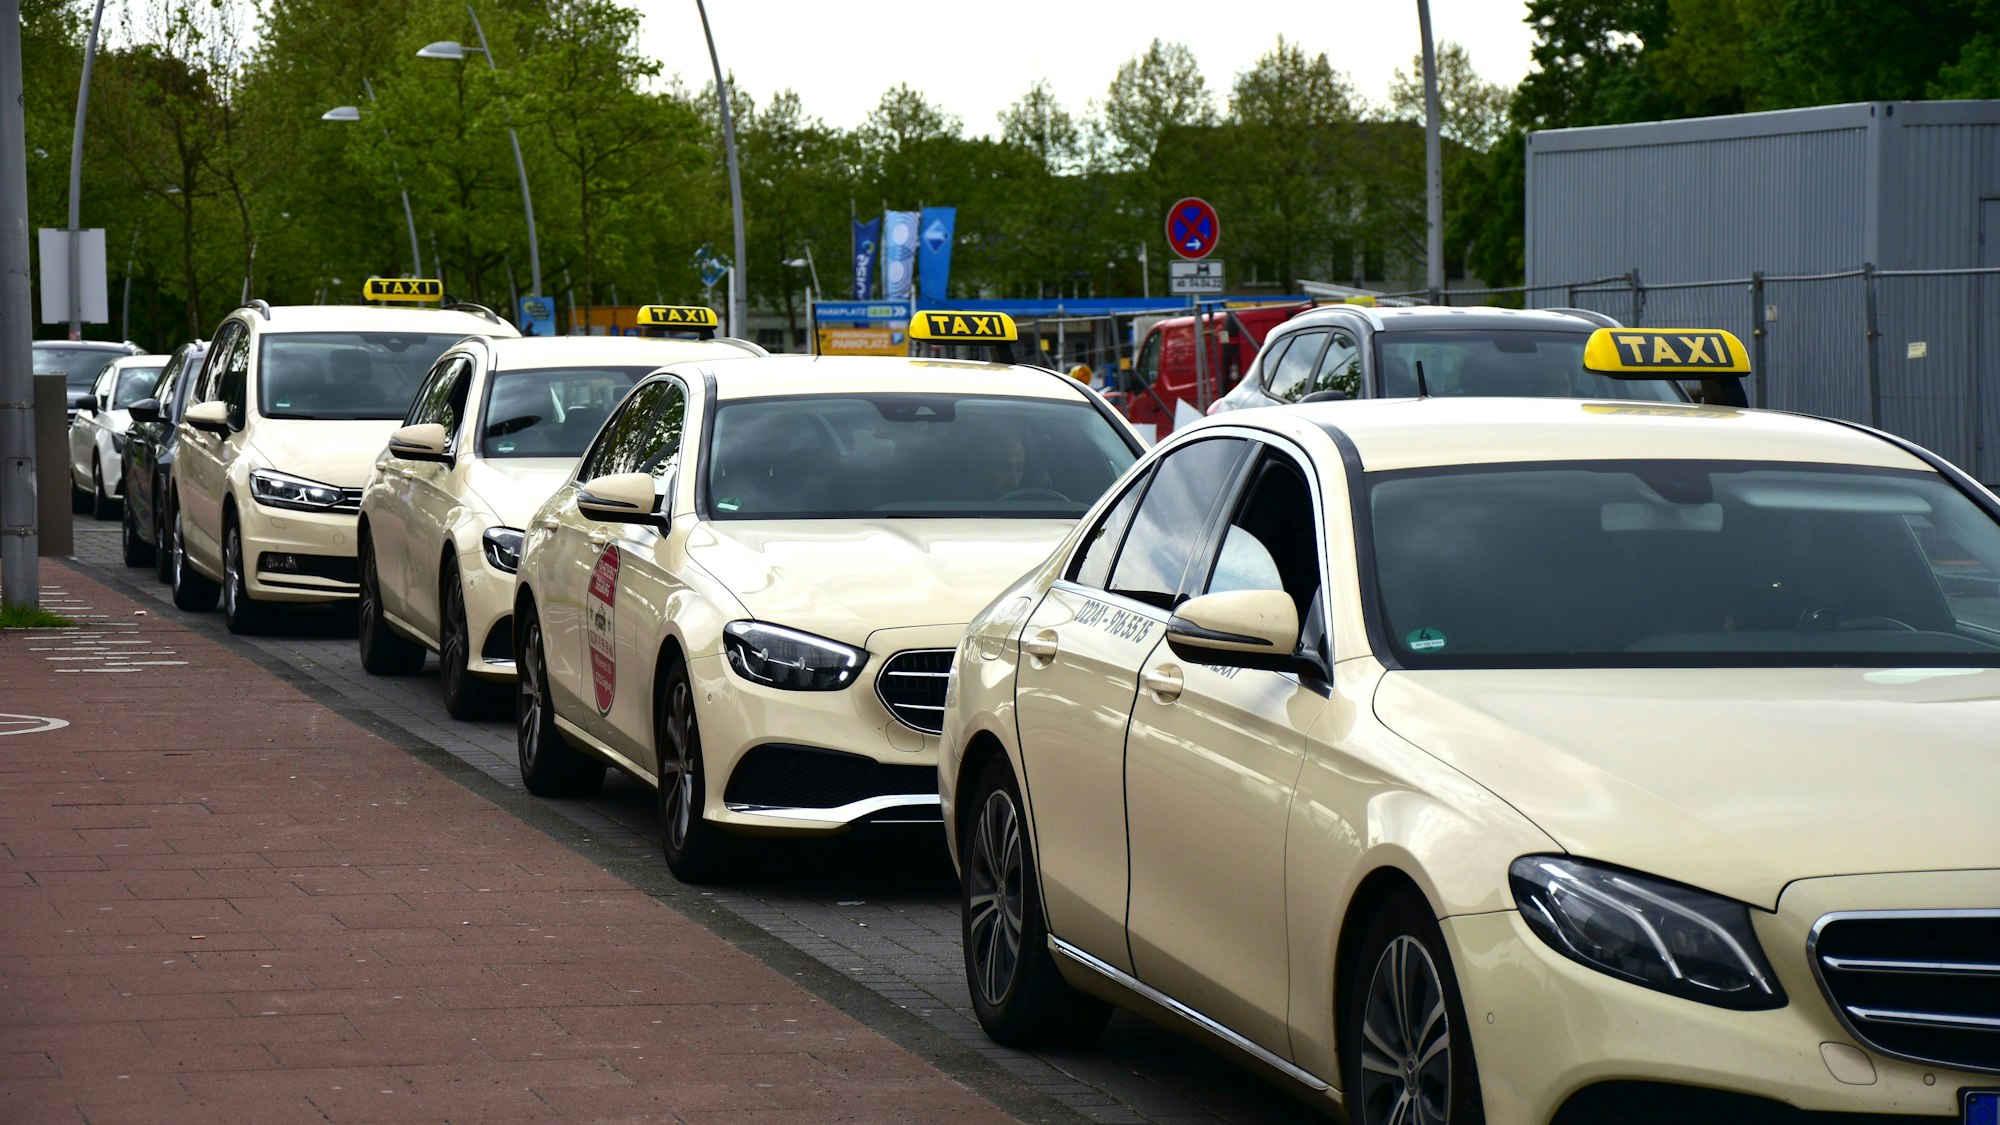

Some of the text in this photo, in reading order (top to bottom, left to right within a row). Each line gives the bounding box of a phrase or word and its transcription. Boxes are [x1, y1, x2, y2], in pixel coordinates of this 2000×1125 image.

[379, 281, 430, 294] TAXI
[652, 308, 706, 322] TAXI
[930, 315, 1002, 335] TAXI
[1617, 335, 1728, 364] TAXI
[1074, 600, 1109, 628] 02241
